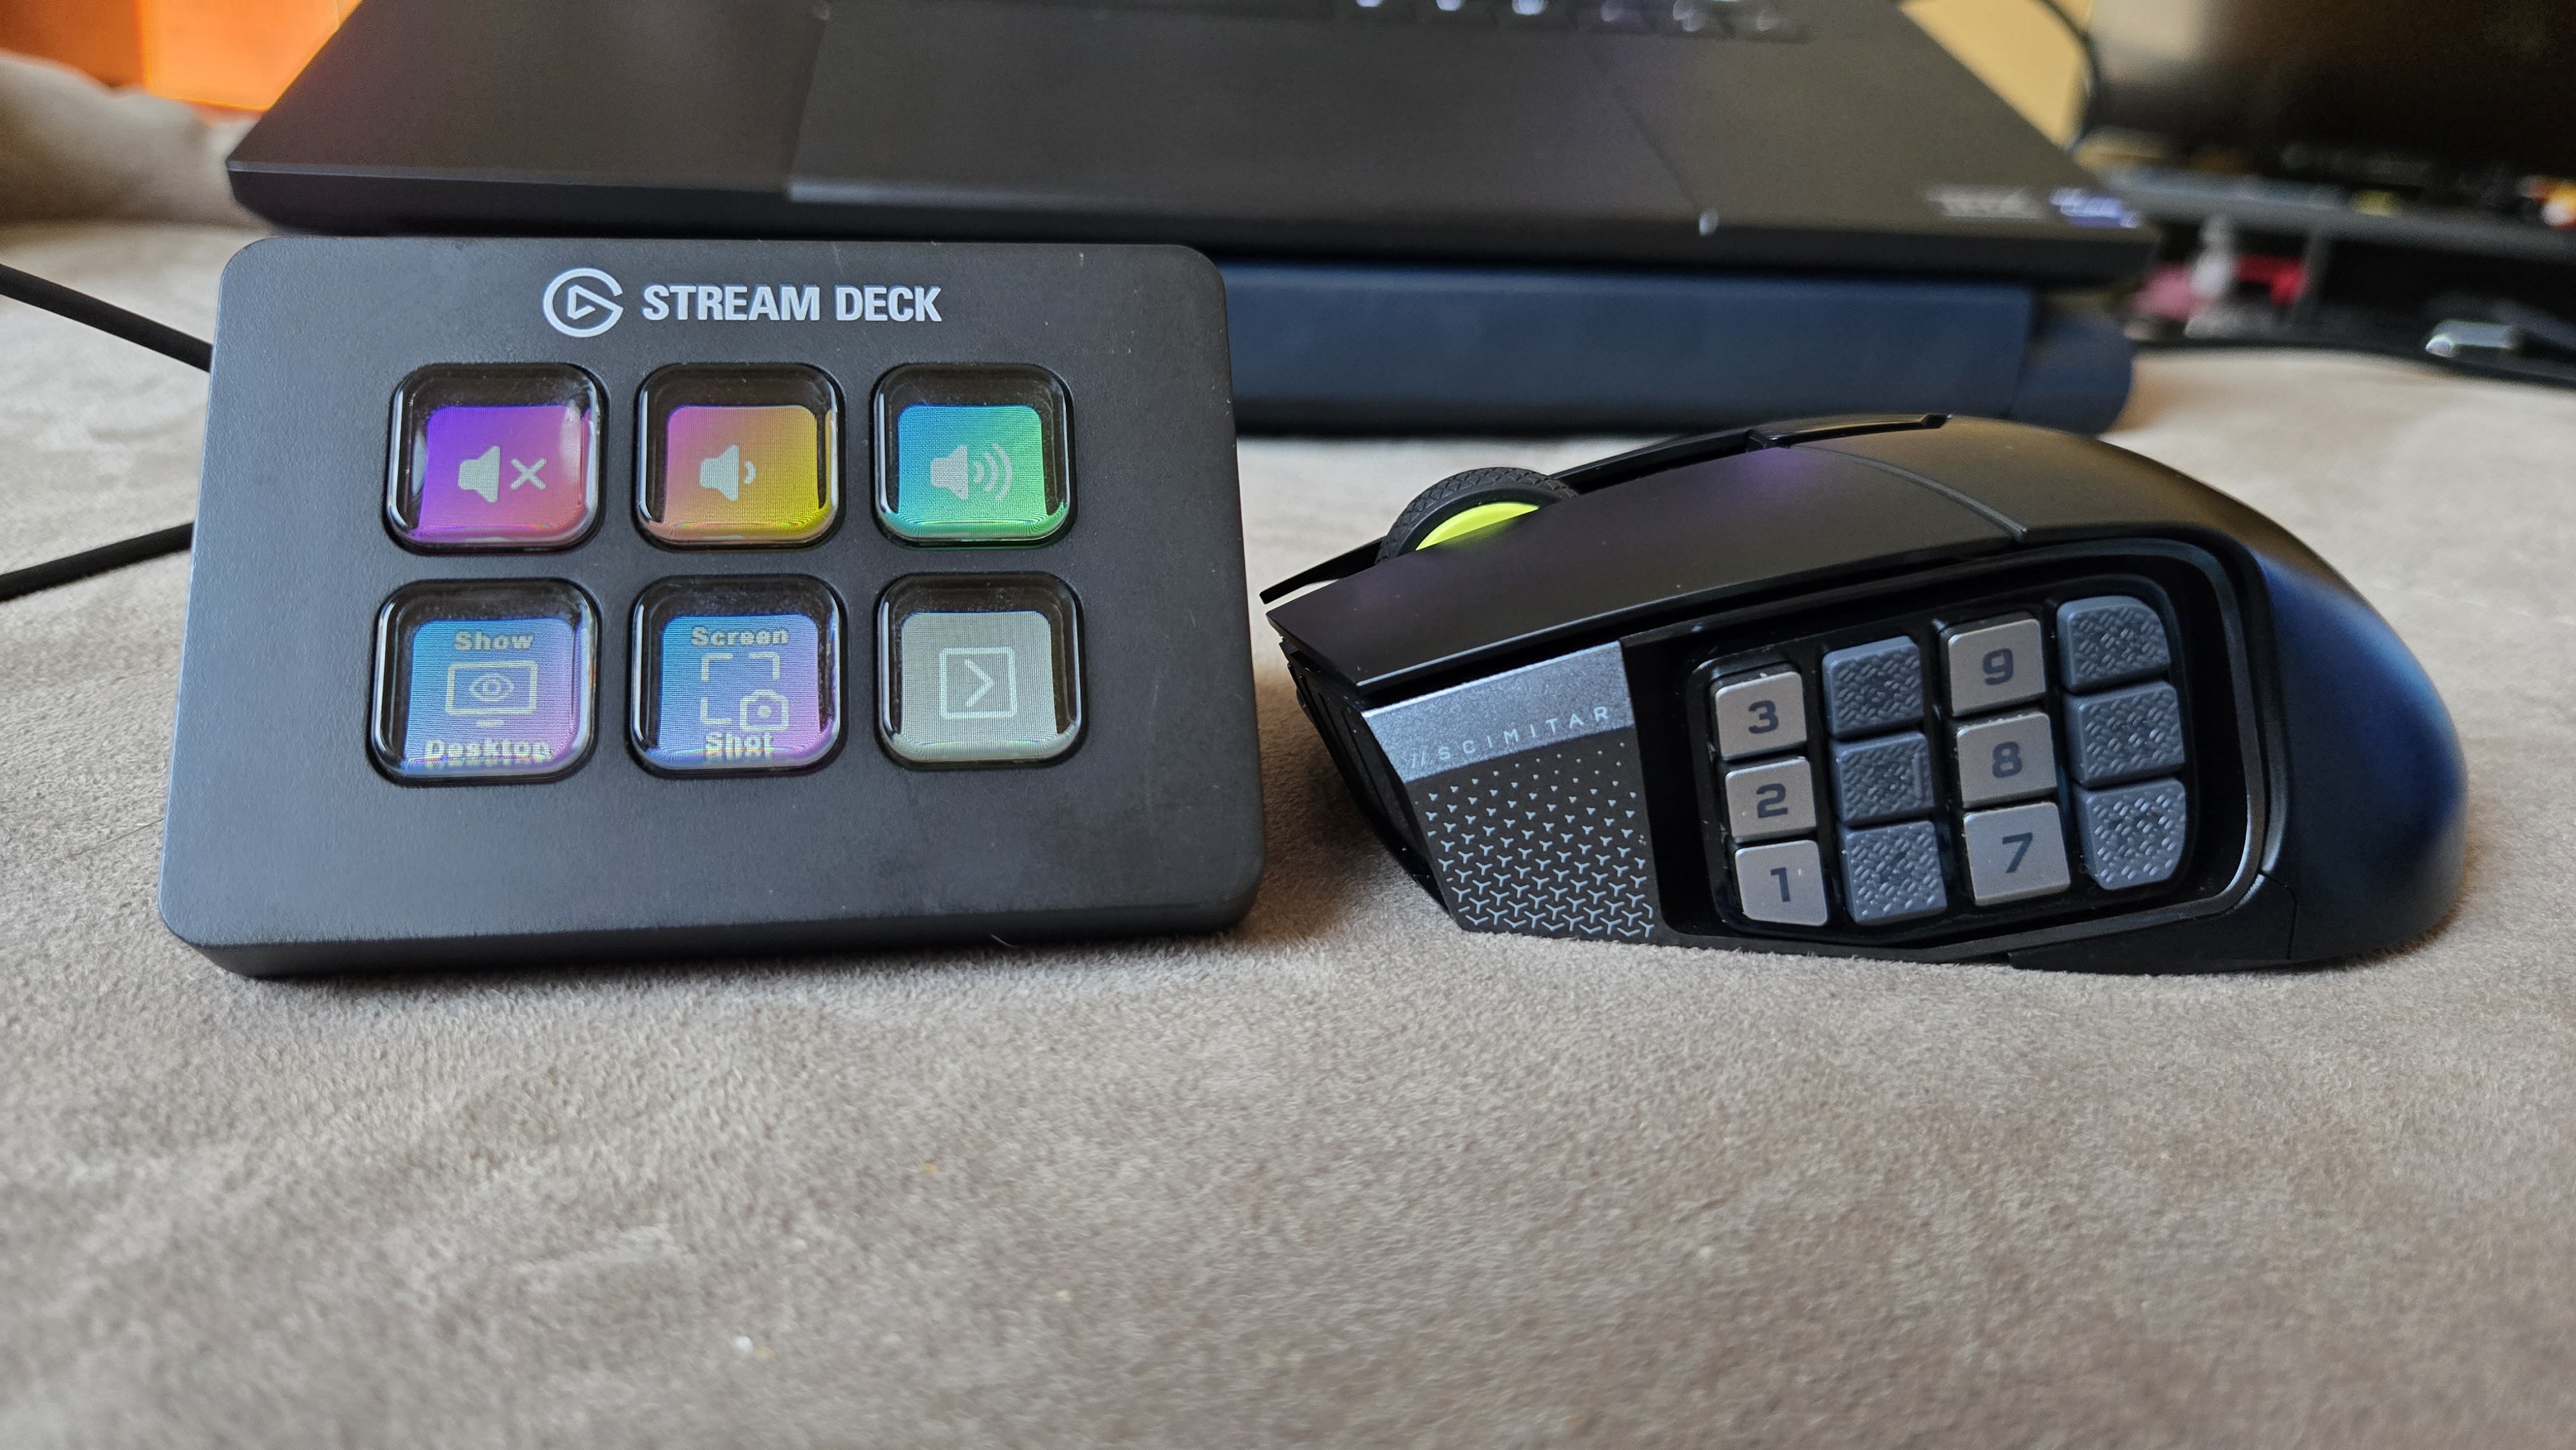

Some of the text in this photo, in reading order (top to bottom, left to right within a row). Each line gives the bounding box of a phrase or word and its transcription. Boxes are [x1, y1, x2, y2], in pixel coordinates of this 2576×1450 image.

[642, 283, 942, 321] STREAM DECK
[454, 630, 535, 652] Show
[690, 626, 790, 646] Screen
[1982, 649, 2014, 685] 9
[1748, 700, 1779, 734] 3
[423, 739, 551, 761] Desktop
[705, 732, 774, 756] Shot
[1992, 742, 2022, 778] 8
[1756, 783, 1788, 819] 2
[2002, 832, 2033, 874] 7
[1770, 867, 1791, 903] 1
